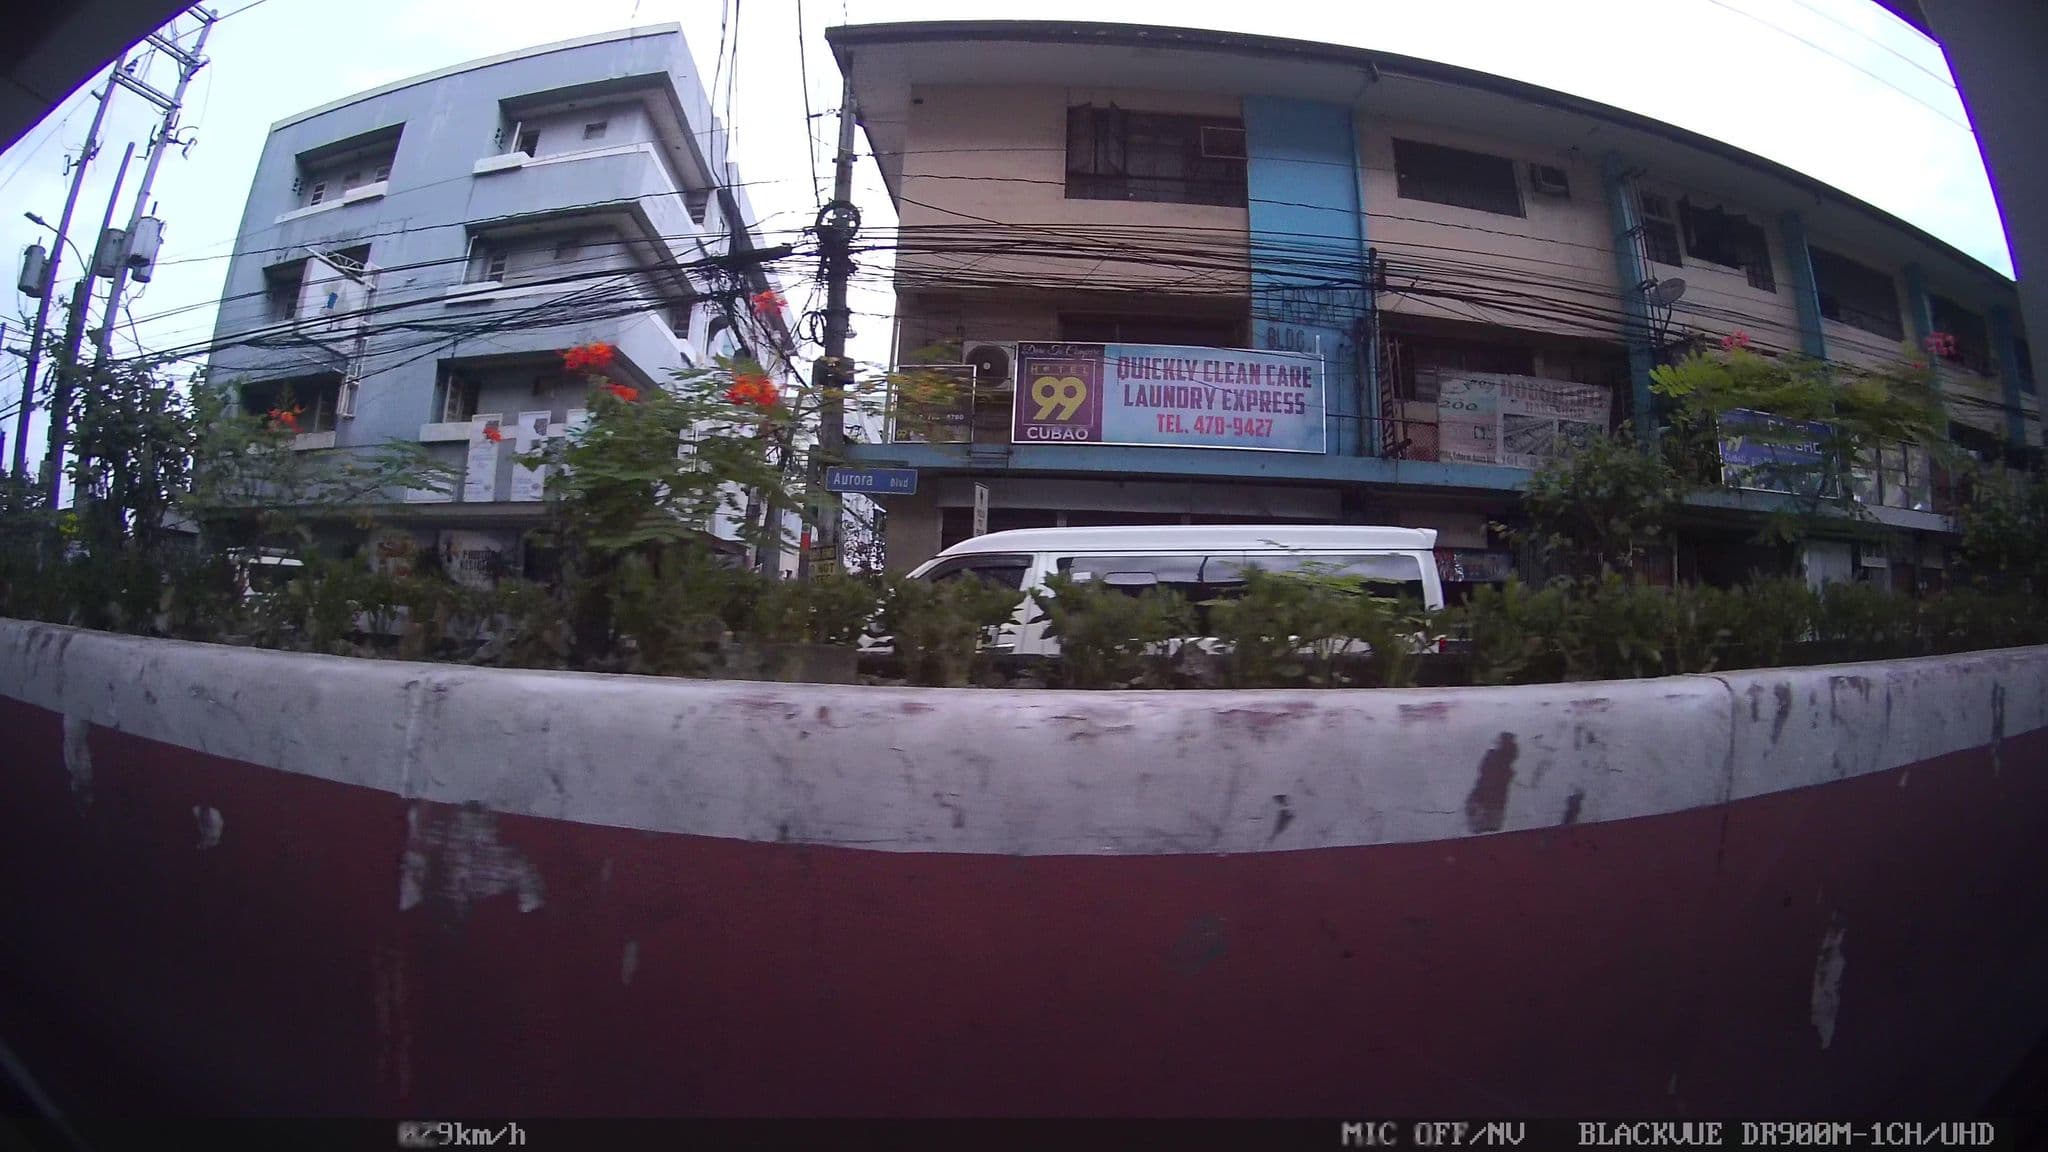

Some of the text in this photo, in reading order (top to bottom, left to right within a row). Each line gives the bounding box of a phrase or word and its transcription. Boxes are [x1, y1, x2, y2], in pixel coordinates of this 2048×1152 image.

[1117, 356, 1313, 388] QUICKLY CLEAN CARE
[1031, 376, 1087, 421] 99
[1123, 384, 1306, 415] LAUNDRY EXPRESS
[1026, 427, 1089, 440] CUBAO
[1156, 414, 1274, 438] TEL. 470-9427
[833, 472, 909, 488] Aurora Blvd
